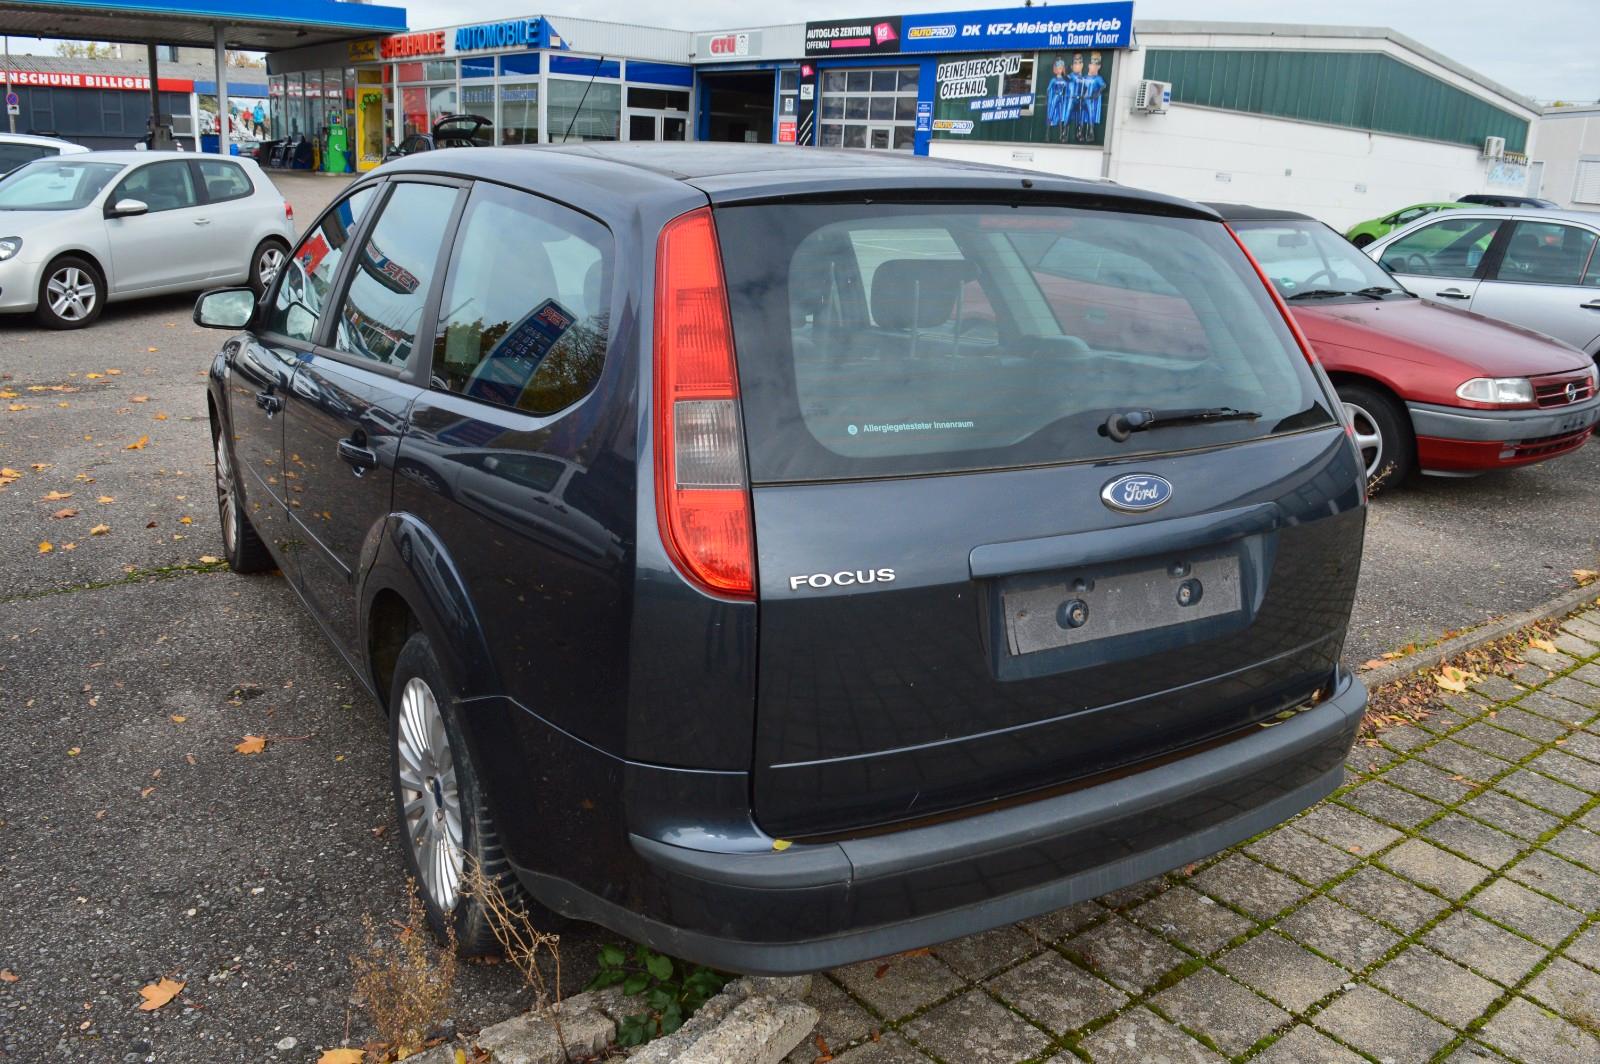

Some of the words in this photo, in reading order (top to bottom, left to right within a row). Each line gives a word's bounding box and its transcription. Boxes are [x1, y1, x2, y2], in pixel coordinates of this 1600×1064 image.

[455, 18, 540, 50] AUTOMOBILE
[807, 28, 839, 39] AUTOGLAS
[840, 26, 871, 37] ZENTRUM
[962, 25, 981, 36] DK
[987, 18, 1121, 35] KFZ-Meisterbetrieb
[806, 40, 829, 49] OFFENAU
[1049, 34, 1064, 45] Inh.
[1067, 33, 1092, 46] Danny
[1095, 32, 1119, 44] Knorr
[938, 63, 965, 79] DEINE
[967, 59, 1005, 76] HEROES
[1008, 57, 1020, 72] IN
[942, 80, 987, 97] OFFENAU.
[1006, 97, 1020, 106] DICH
[863, 422, 932, 433] Allergiegetesteter
[934, 421, 974, 429] Innenraum
[1124, 481, 1159, 502] Ford
[790, 568, 896, 590] FOCUS
